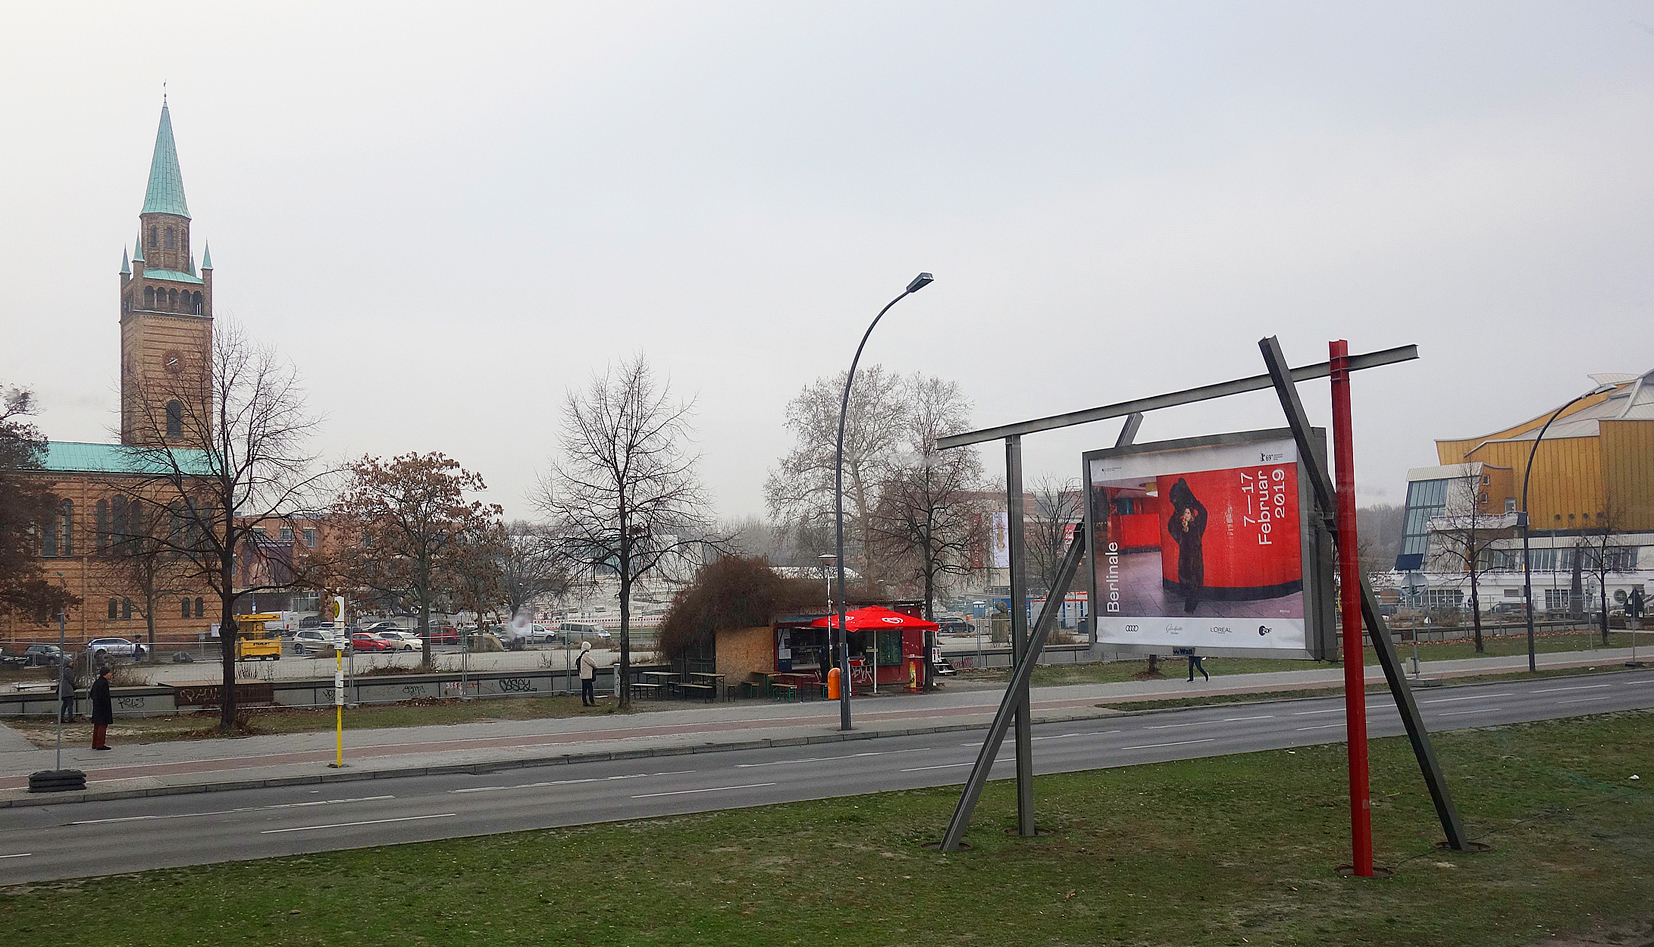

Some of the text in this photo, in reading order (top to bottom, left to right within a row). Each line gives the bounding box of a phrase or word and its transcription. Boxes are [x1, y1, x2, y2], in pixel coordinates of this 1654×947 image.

[1258, 470, 1272, 545] Februar
[1272, 469, 1285, 518] 2019
[1105, 541, 1120, 613] Berlinale
